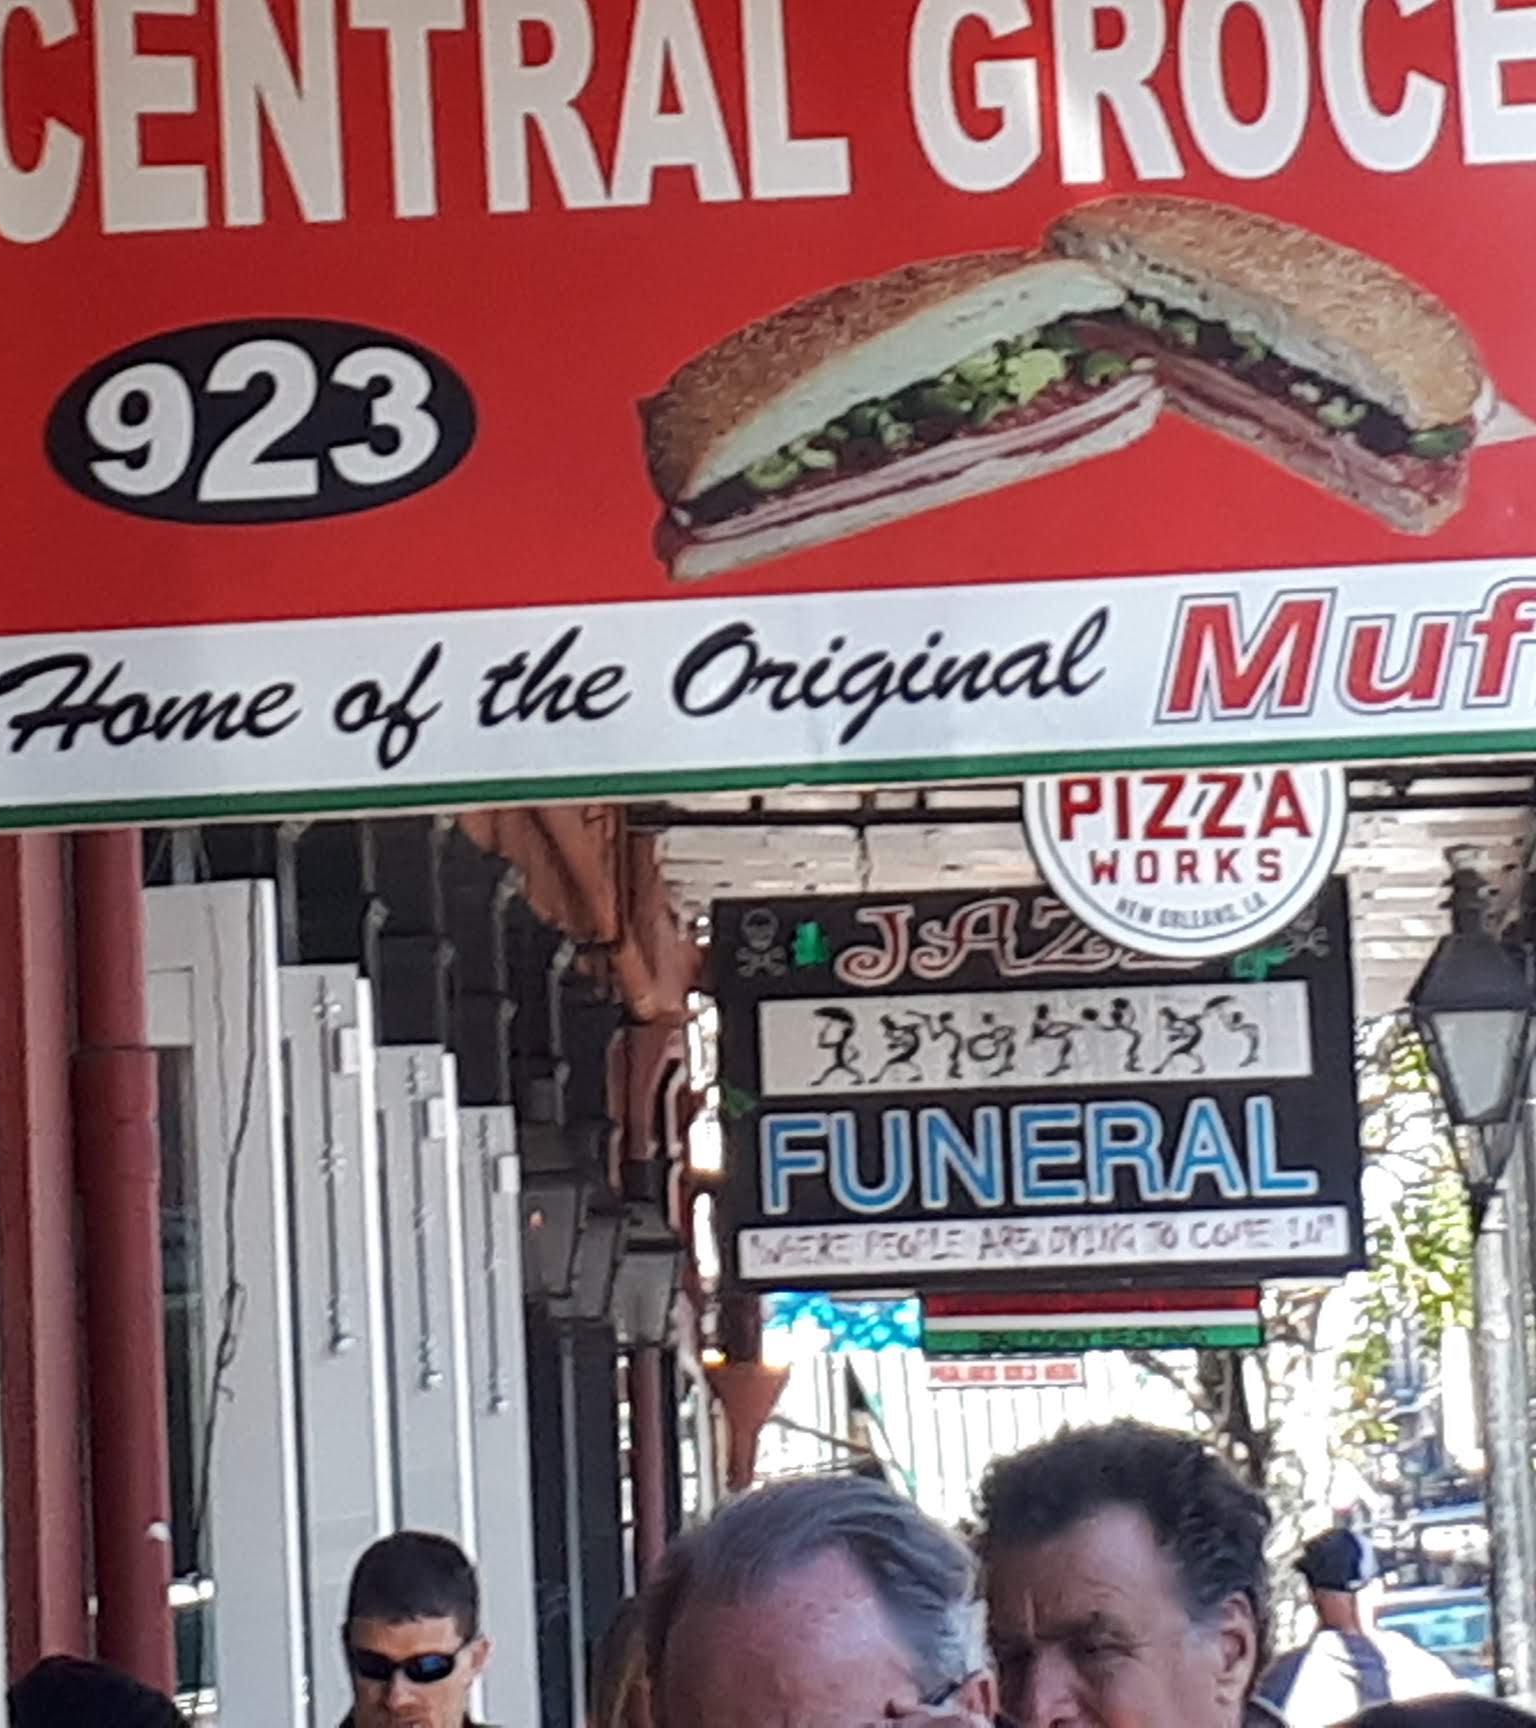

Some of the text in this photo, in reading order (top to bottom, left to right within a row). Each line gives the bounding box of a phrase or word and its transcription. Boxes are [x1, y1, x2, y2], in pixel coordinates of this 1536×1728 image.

[85, 337, 440, 503] 923
[333, 643, 442, 770] of
[478, 626, 626, 729] the
[672, 606, 1109, 744] Original
[1058, 770, 1314, 841] PIZZA
[1088, 848, 1283, 885] WORKS
[833, 896, 1204, 988] JAZ
[761, 1096, 1319, 1215] FUNERAL
